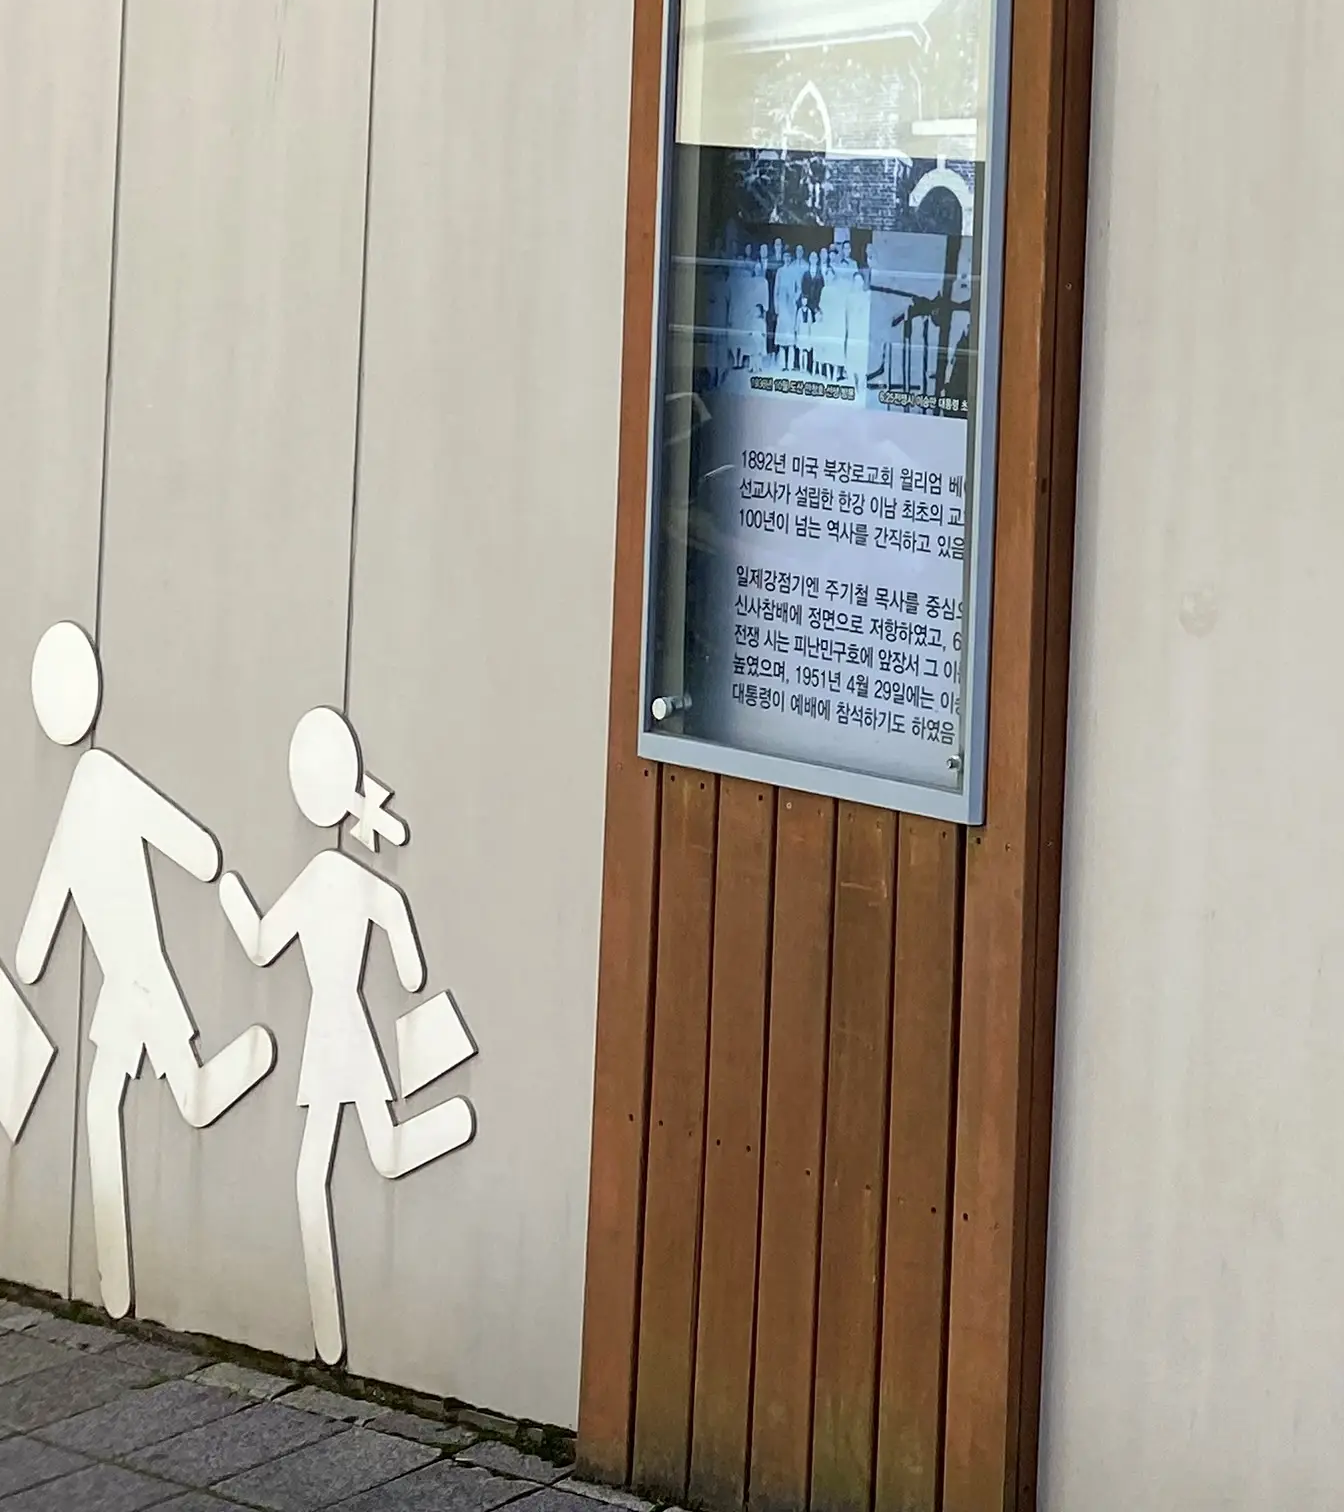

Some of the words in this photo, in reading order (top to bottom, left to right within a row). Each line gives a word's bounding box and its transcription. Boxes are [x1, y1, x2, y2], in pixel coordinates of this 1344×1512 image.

[938, 398, 959, 410] 대통령
[742, 450, 786, 474] 1892년
[792, 456, 819, 479] 미국
[824, 459, 893, 489] 북장로교회
[900, 468, 942, 495] 윌리엄
[740, 478, 791, 504] 선교사가
[795, 486, 833, 511] 설립한
[839, 491, 865, 515] 한강
[870, 496, 897, 519] 이남
[902, 500, 943, 526] 최초의
[740, 509, 789, 534] 100년이
[795, 515, 821, 539] 넘는
[827, 520, 869, 546] 역사를
[874, 527, 931, 553] 간직하고
[736, 565, 819, 599] 일제강점기엔
[825, 580, 868, 607] 주기철
[875, 587, 920, 615] 목사를
[735, 594, 802, 626] 신사참배에
[808, 607, 864, 634] 정면으로
[870, 618, 946, 652] 저항하였고,
[735, 624, 760, 648] 전쟁
[764, 629, 789, 653] 시는
[794, 635, 873, 669] 피난민구호에
[878, 649, 919, 677] 앞장서
[923, 658, 938, 677] 그
[944, 660, 960, 684] 이
[732, 652, 789, 684] 높였으며,
[796, 665, 841, 693] 1951년
[847, 674, 868, 699] 4월
[874, 679, 935, 710] 29일에는
[732, 683, 785, 713] 대통령이
[791, 693, 831, 721] 예배에
[836, 701, 905, 734] 참석하기도
[912, 716, 955, 745] 하였음
